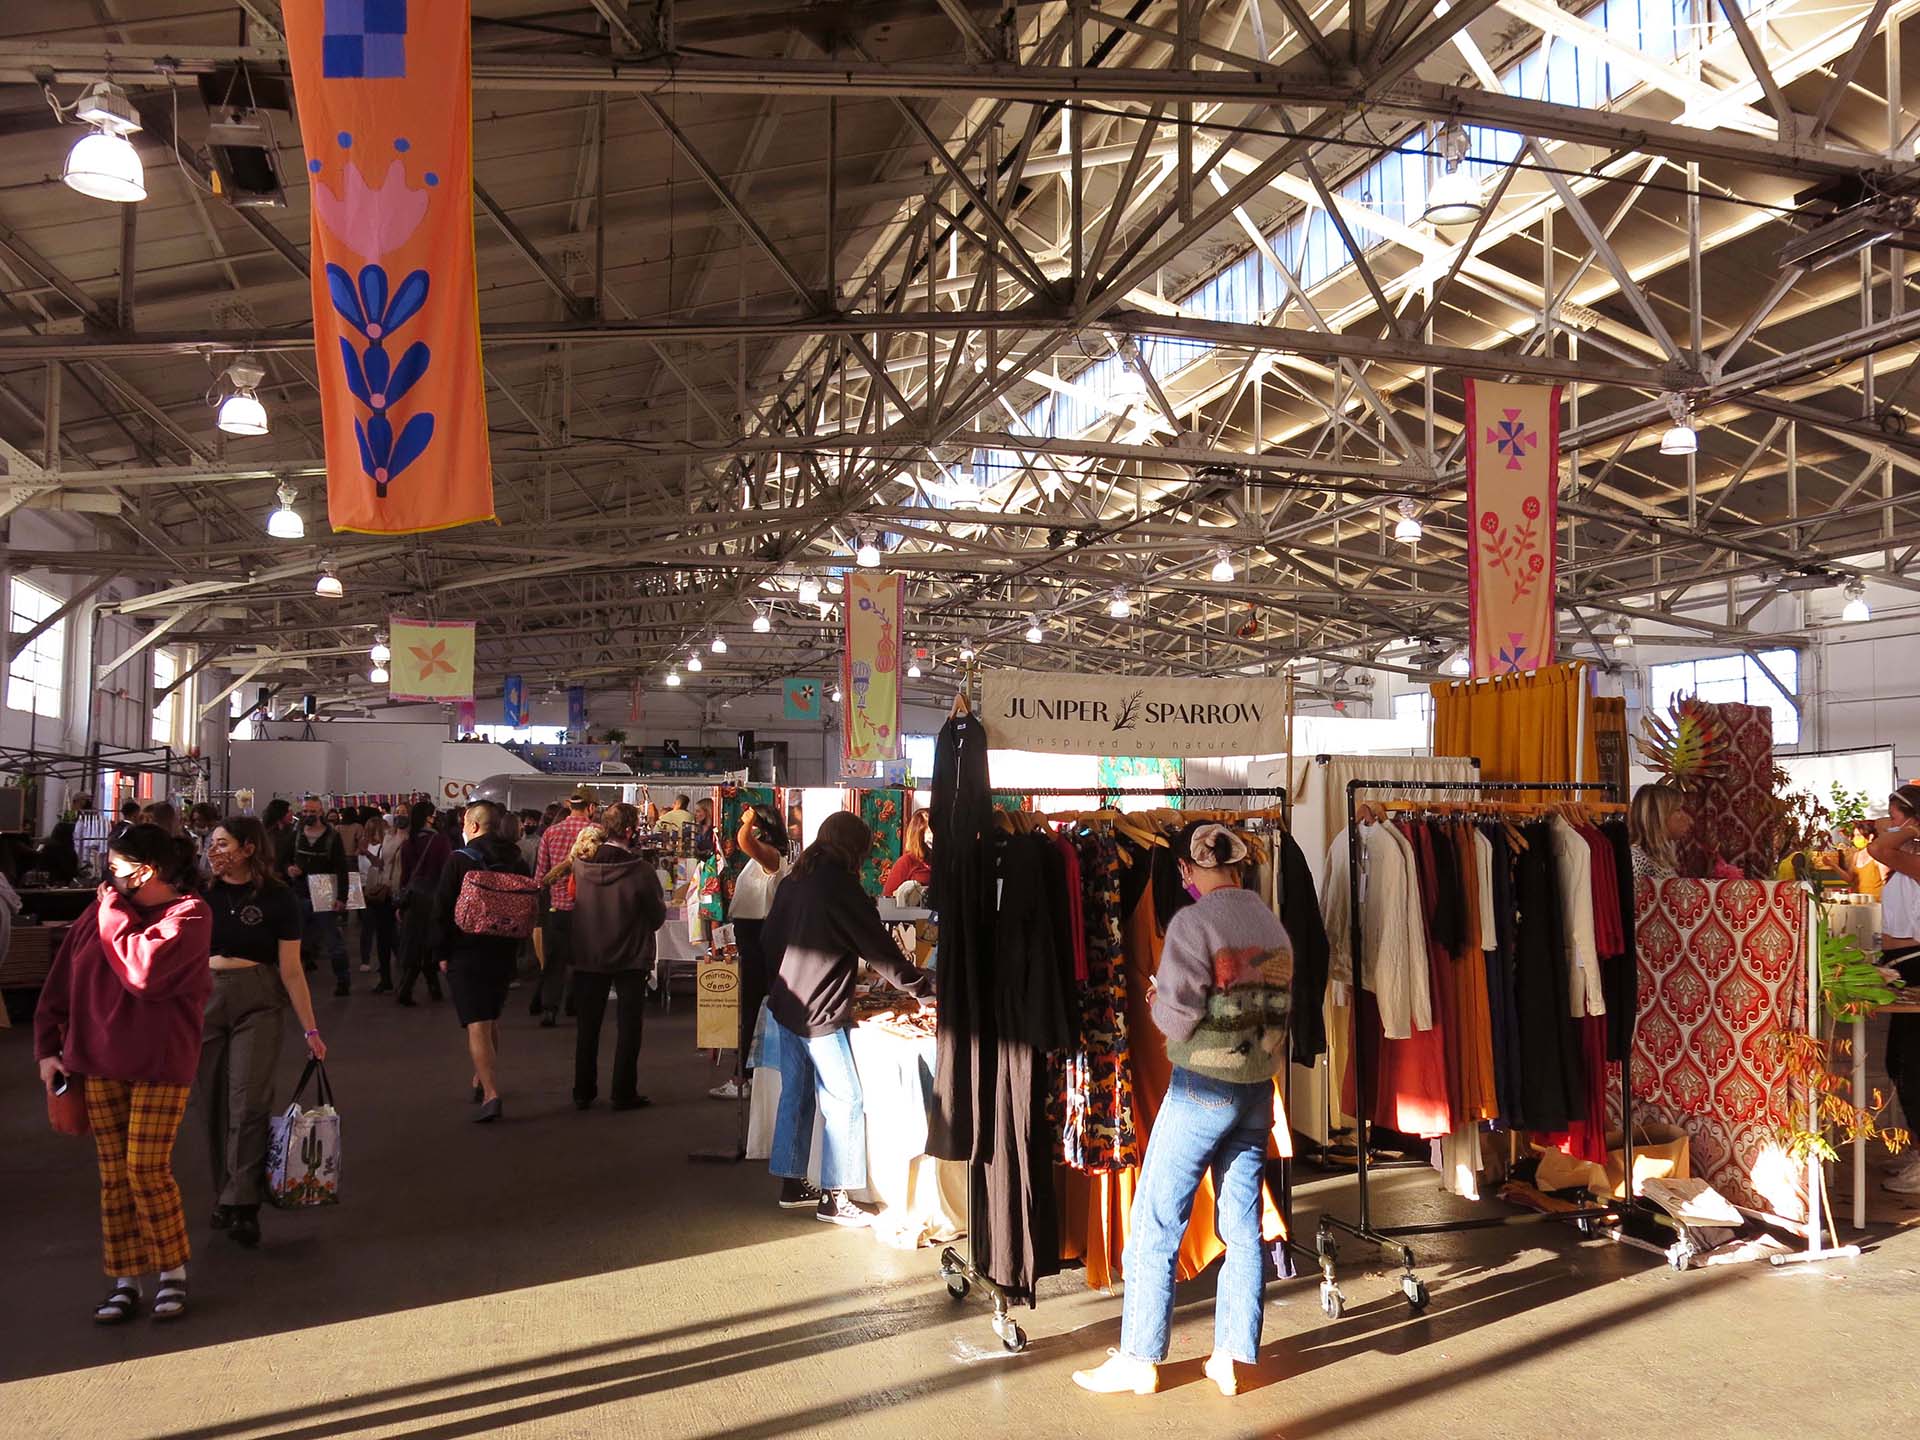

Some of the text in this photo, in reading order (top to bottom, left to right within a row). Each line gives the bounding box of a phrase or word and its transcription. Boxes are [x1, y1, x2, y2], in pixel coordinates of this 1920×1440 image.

[1004, 698, 1264, 724] JUNIPER SPARROW
[1026, 736, 1238, 750] inspired by nature
[705, 972, 732, 980] miriam
